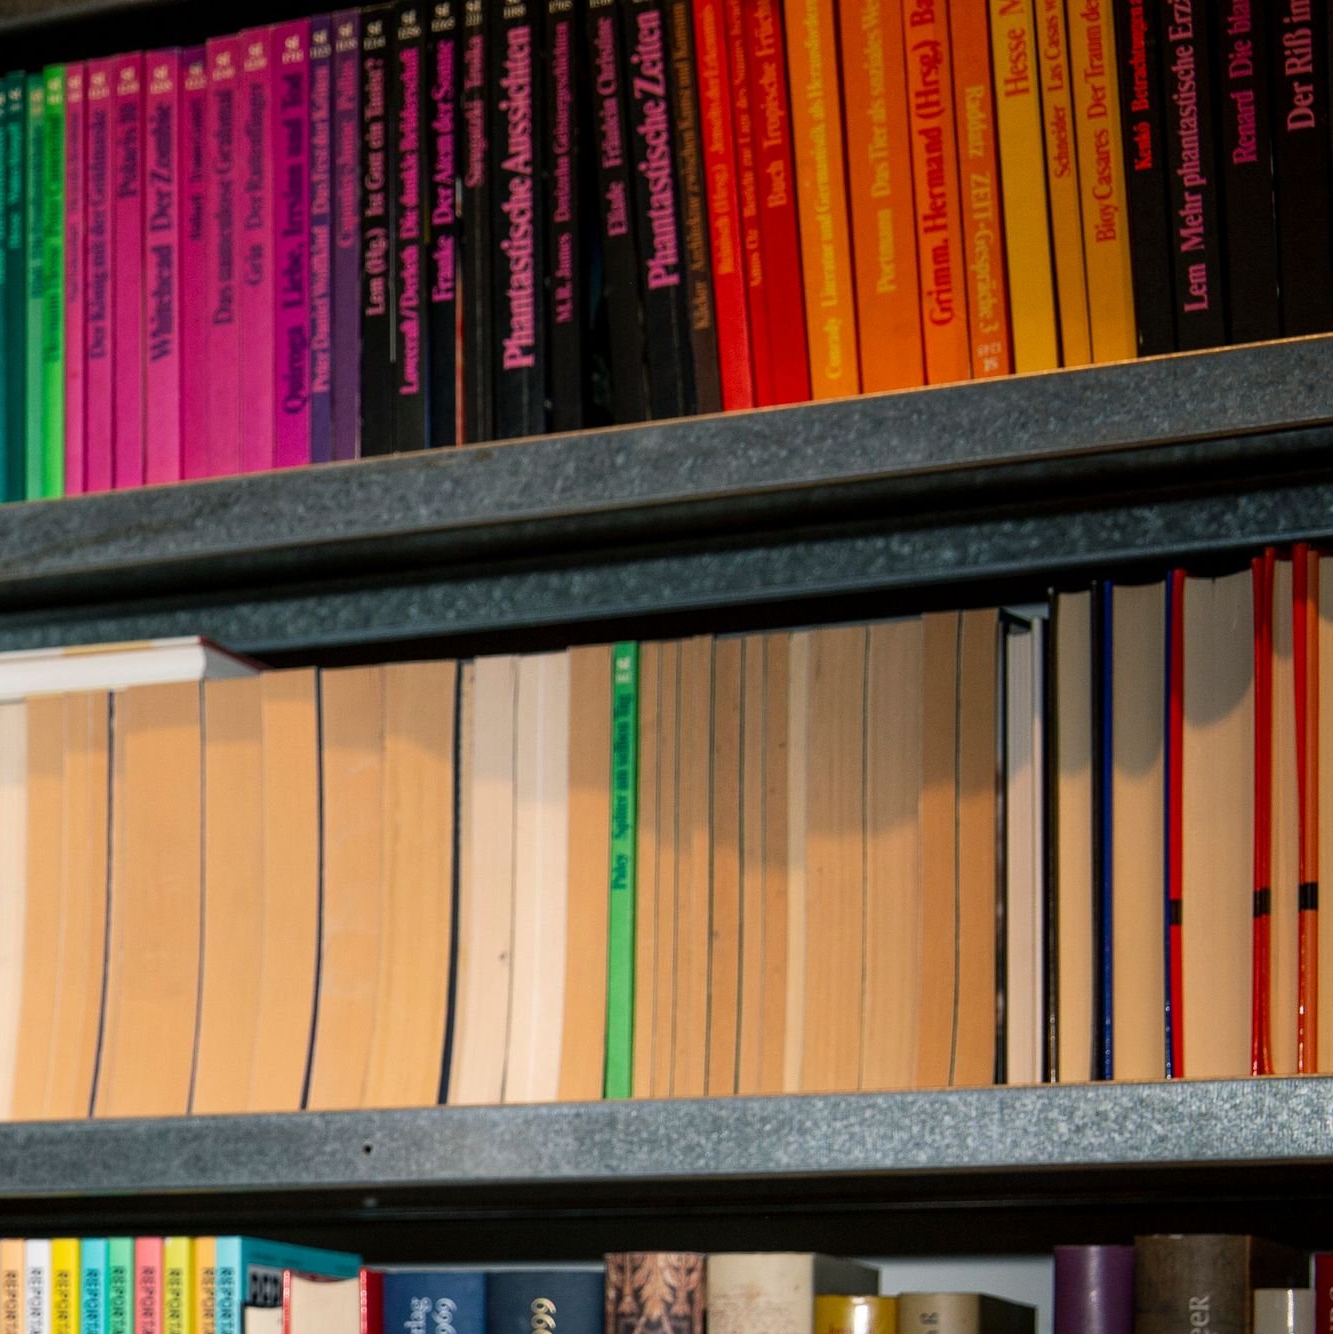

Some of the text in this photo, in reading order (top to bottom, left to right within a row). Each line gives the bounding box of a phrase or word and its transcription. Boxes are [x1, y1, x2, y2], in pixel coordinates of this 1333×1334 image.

[1002, 28, 1031, 98] Hesse
[1042, 15, 1072, 179] Schneider Las Casas
[1128, 5, 1150, 112] Betrachtungen
[1228, 39, 1258, 165] Renard Die
[1283, 27, 1317, 131] Der Riß
[595, 17, 628, 236] Eliade Fräulein Christine
[631, 9, 681, 290] Phantastische Zeiten
[760, 62, 787, 208] Buch Tropische
[868, 125, 891, 160] Tier
[870, 161, 892, 199] Das
[919, 126, 949, 234] Hermand
[1082, 25, 1119, 244] Bioy Casares Der Traum
[1171, 45, 1209, 313] Lem Mehr phantastische
[149, 102, 173, 362] Whitehead Der Zombie
[281, 73, 306, 415] Quiroga Liebe, Irrsinn und Tod
[430, 188, 454, 225] Der
[499, 26, 535, 370] Phantastische Aussichten
[875, 207, 898, 294] Portmann
[365, 277, 385, 316] Lem
[431, 235, 454, 302] Franke
